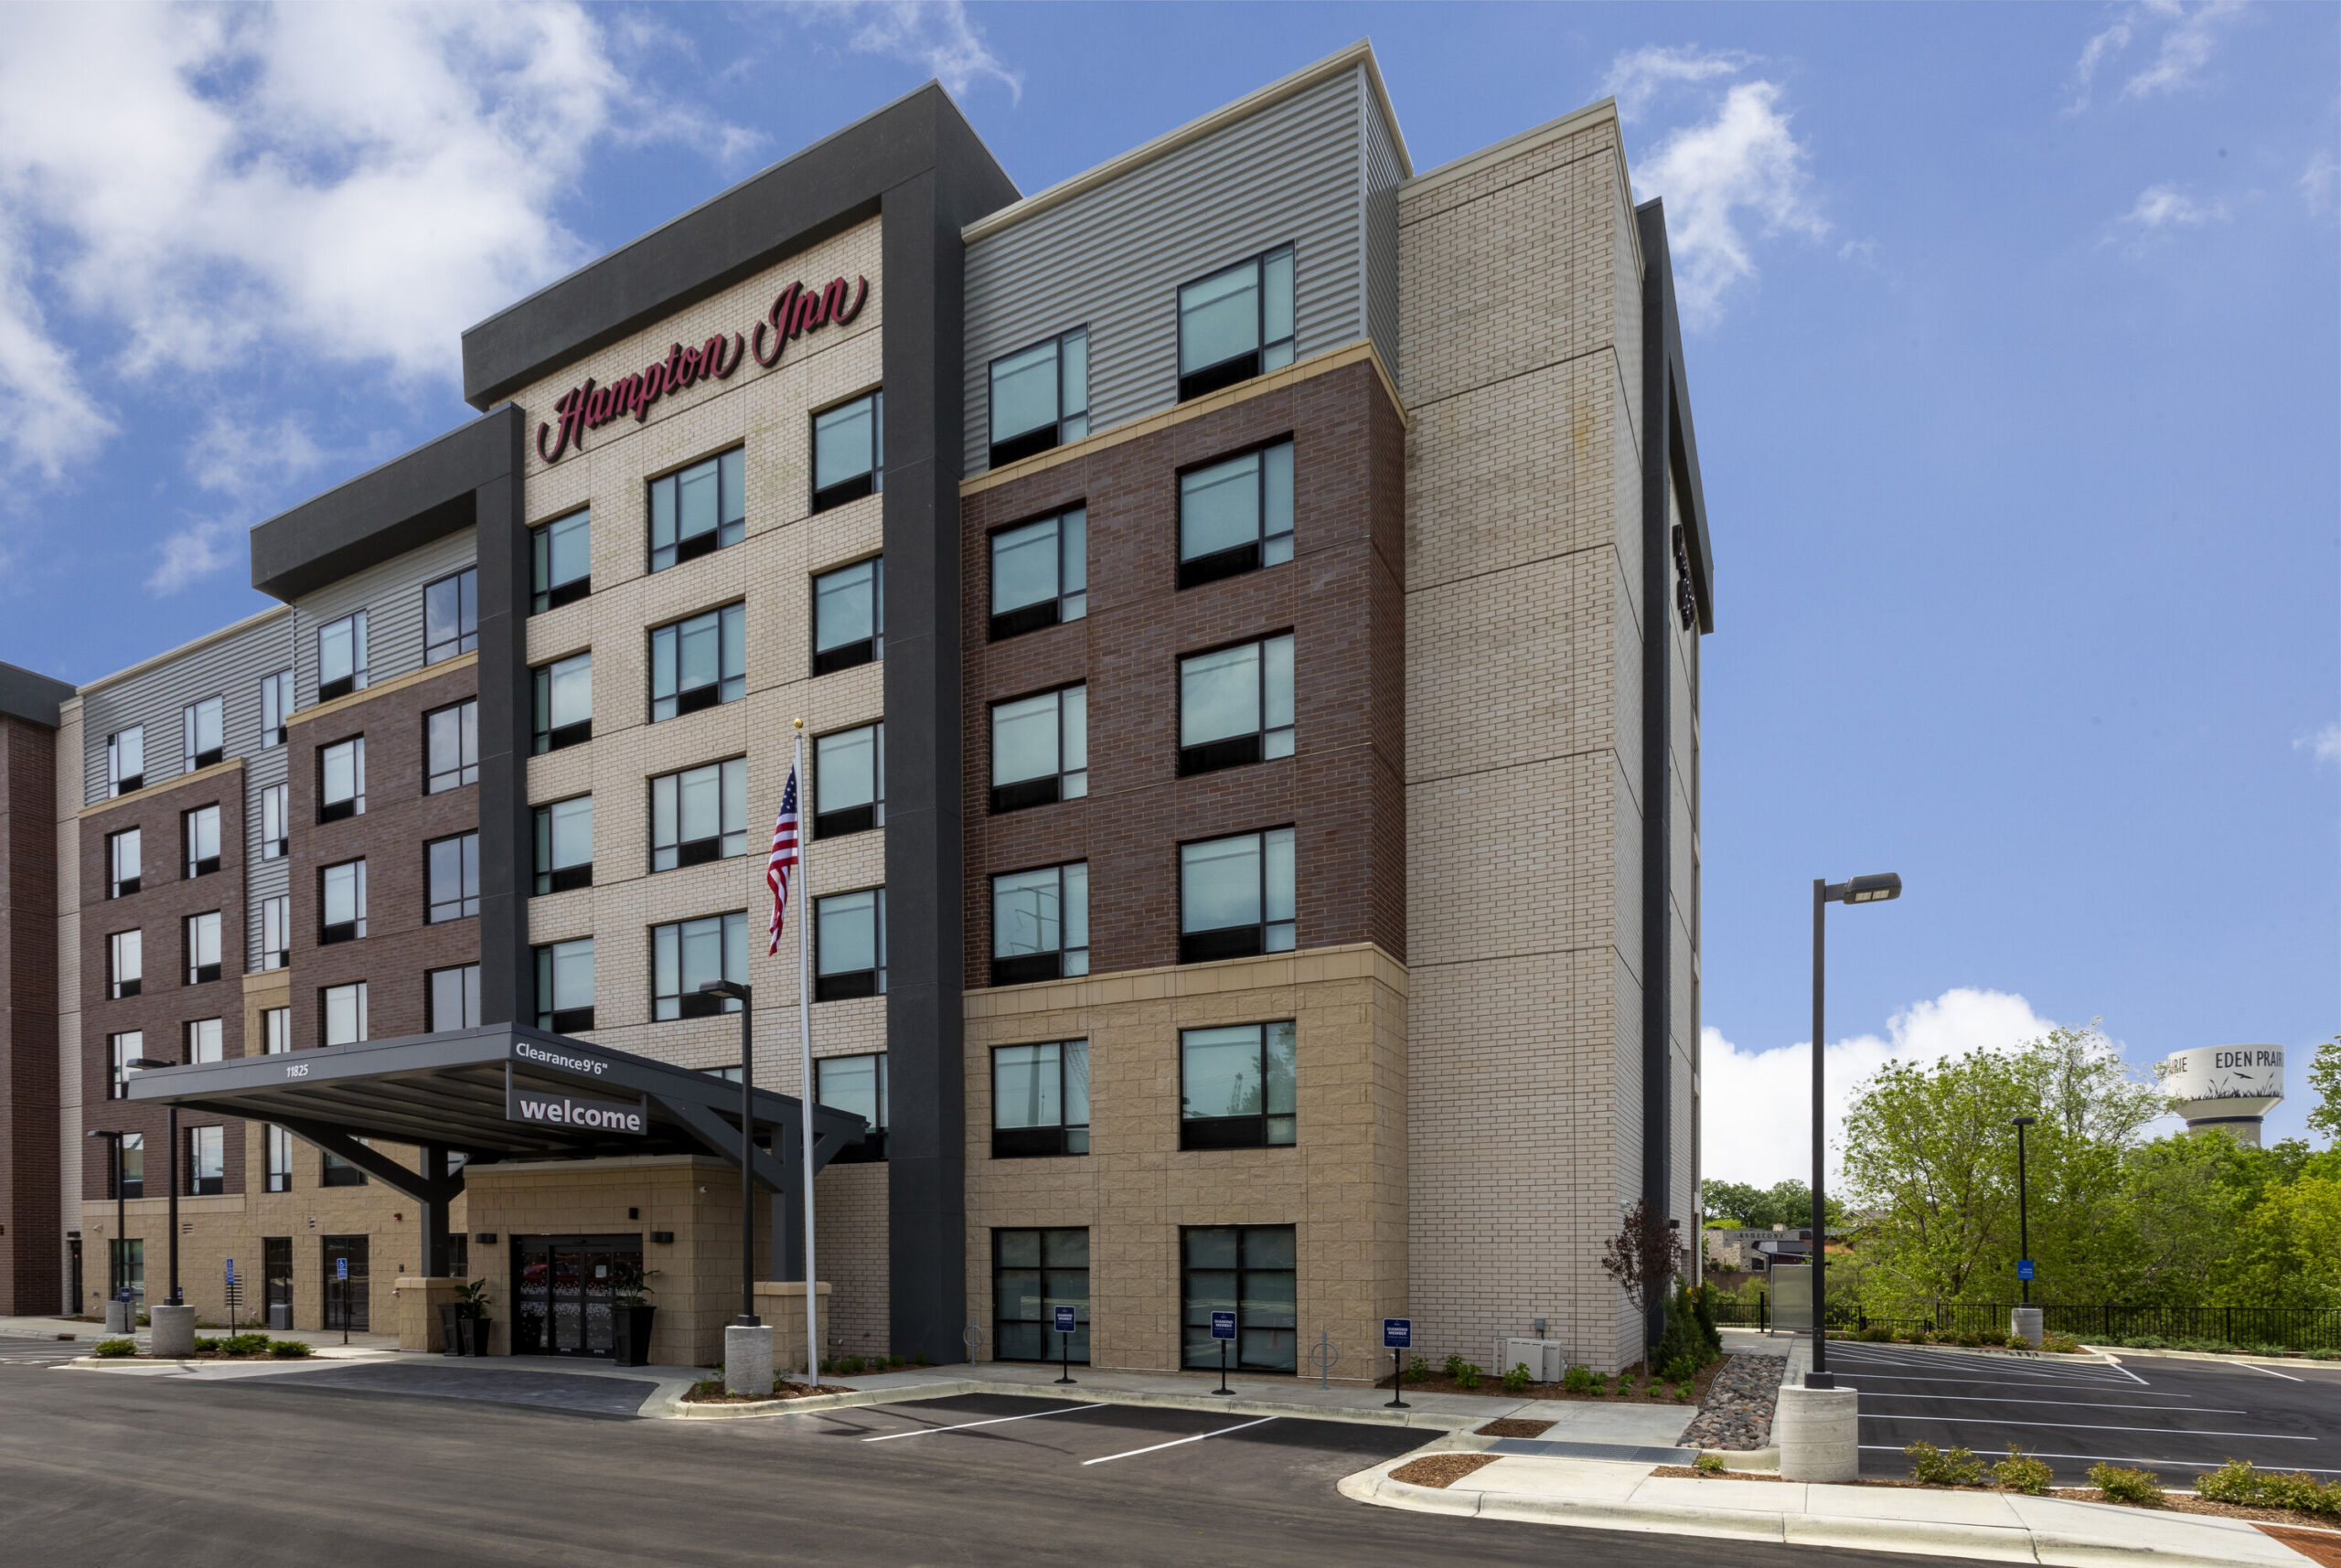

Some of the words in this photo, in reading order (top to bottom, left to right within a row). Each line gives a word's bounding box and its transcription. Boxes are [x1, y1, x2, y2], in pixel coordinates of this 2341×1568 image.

[537, 331, 745, 464] Hampton
[752, 274, 870, 369] Inn
[286, 1063, 309, 1078] 11825
[2216, 1051, 2252, 1069] EDEN
[519, 1099, 641, 1132] welcome
